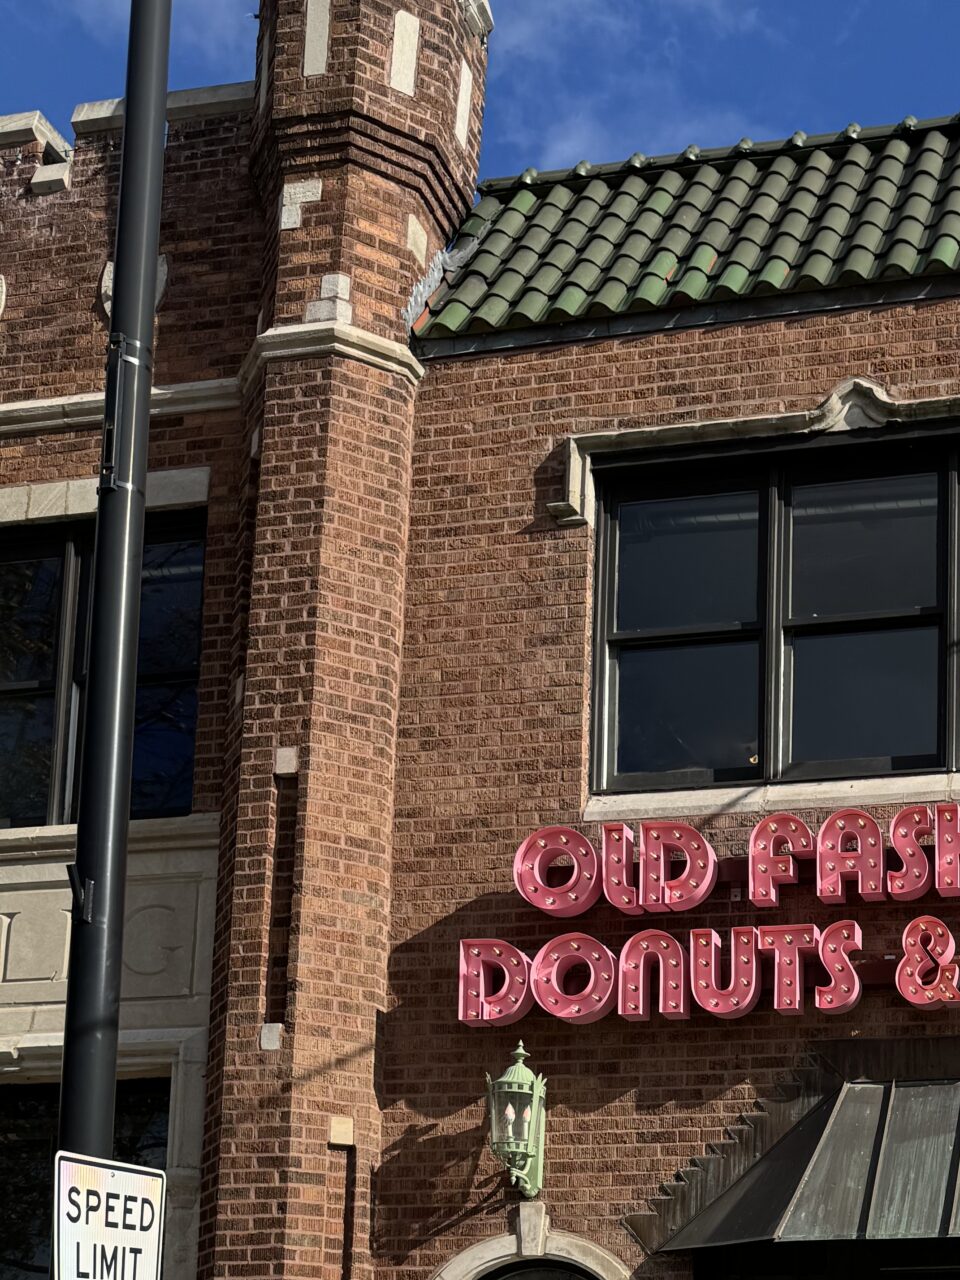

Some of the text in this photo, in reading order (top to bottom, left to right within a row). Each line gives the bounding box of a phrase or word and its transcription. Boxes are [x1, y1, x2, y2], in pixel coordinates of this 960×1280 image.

[513, 826, 718, 917] OLD
[458, 919, 862, 1027] DONUTS
[66, 1186, 155, 1232] SPEED
